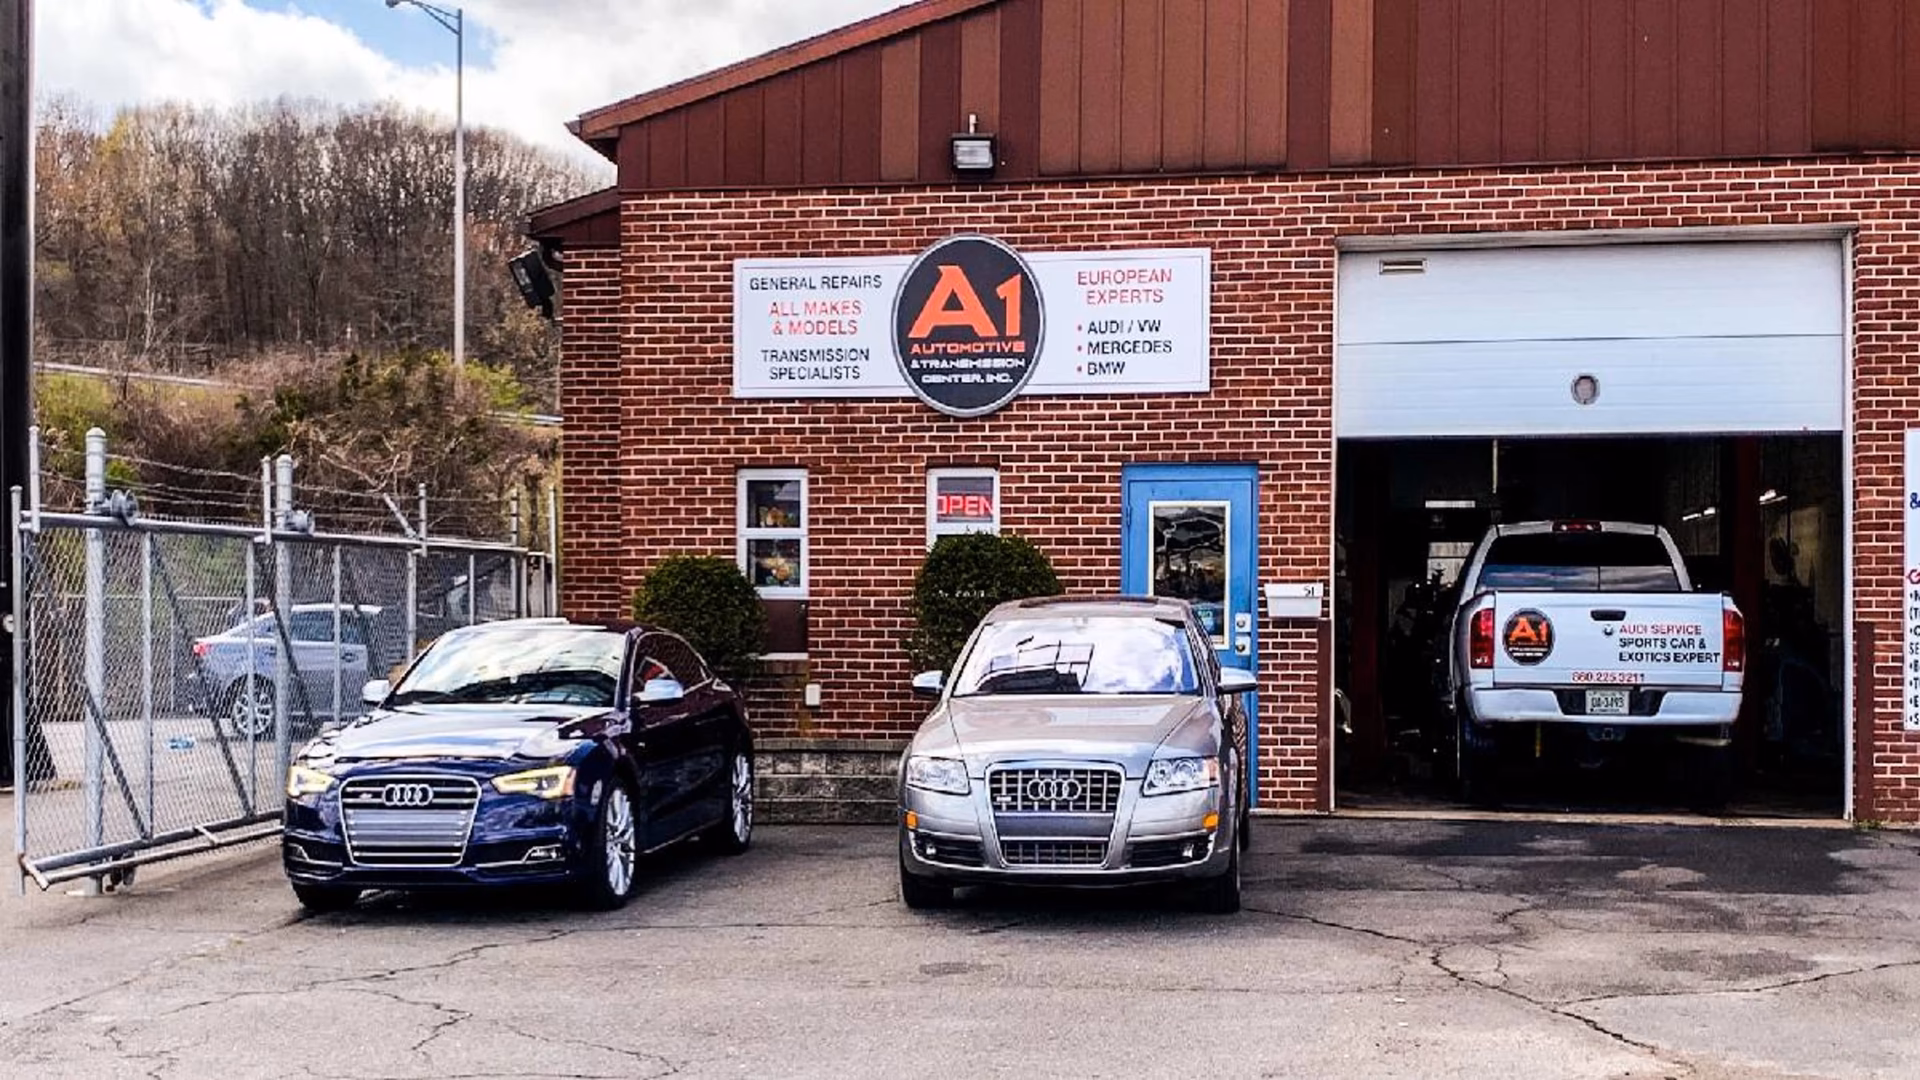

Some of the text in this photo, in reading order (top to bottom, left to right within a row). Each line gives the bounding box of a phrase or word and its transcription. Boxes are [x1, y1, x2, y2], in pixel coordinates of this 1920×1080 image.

[749, 274, 883, 291] GENERAL REPAIRS
[1077, 268, 1172, 286] EUROPEAN
[907, 264, 1022, 338] A1
[1086, 288, 1164, 306] EXPERTS
[768, 300, 862, 317] ALL MAKES
[772, 319, 859, 336] & MODELS
[1087, 319, 1124, 335] AUDI
[1137, 319, 1162, 333] VW
[760, 347, 870, 362] TRANSMISSION
[910, 341, 1026, 354] AUTOMOTIVE
[1087, 339, 1173, 356] MERCEDES
[769, 364, 861, 381] SPECIALISTS
[1087, 360, 1126, 376] BMW
[1303, 585, 1315, 597] 51
[1508, 616, 1548, 642] A1
[1619, 624, 1702, 636] AUDI SERVICE
[1619, 637, 1707, 650] SPORTS CAR &
[1618, 651, 1721, 663] EXOTICS EXPERT
